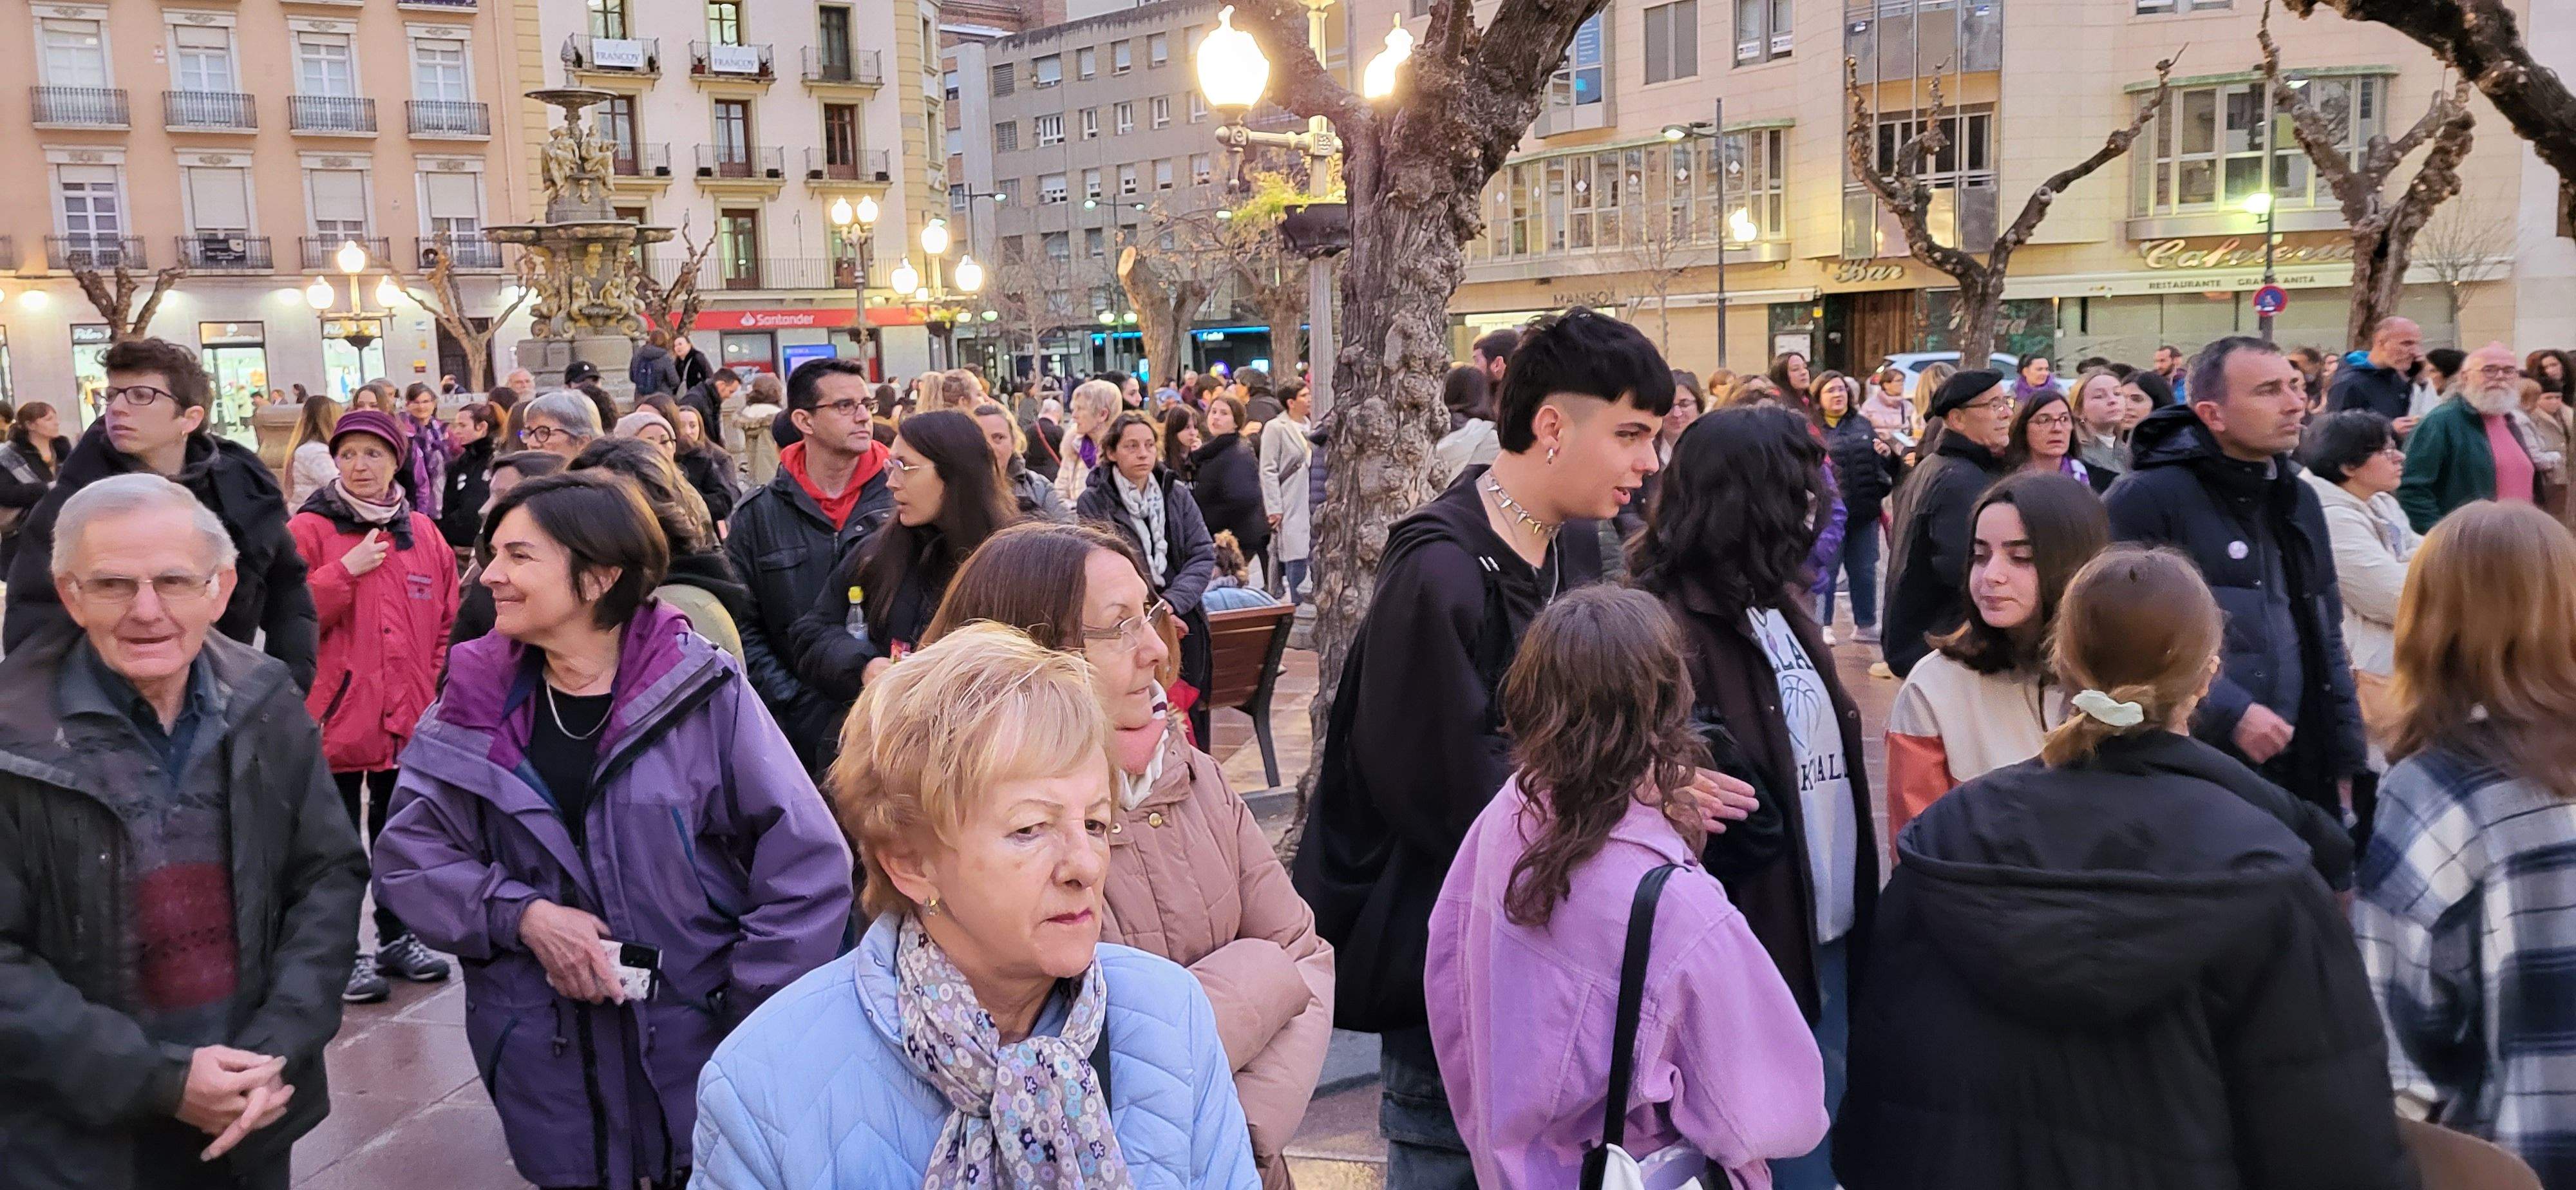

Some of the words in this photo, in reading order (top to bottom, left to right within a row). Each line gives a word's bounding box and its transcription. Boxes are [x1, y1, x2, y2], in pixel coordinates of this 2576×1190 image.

[2148, 279, 2222, 290] RESTAURANTE
[2283, 276, 2316, 284] ANITA
[756, 314, 815, 326] Santander
